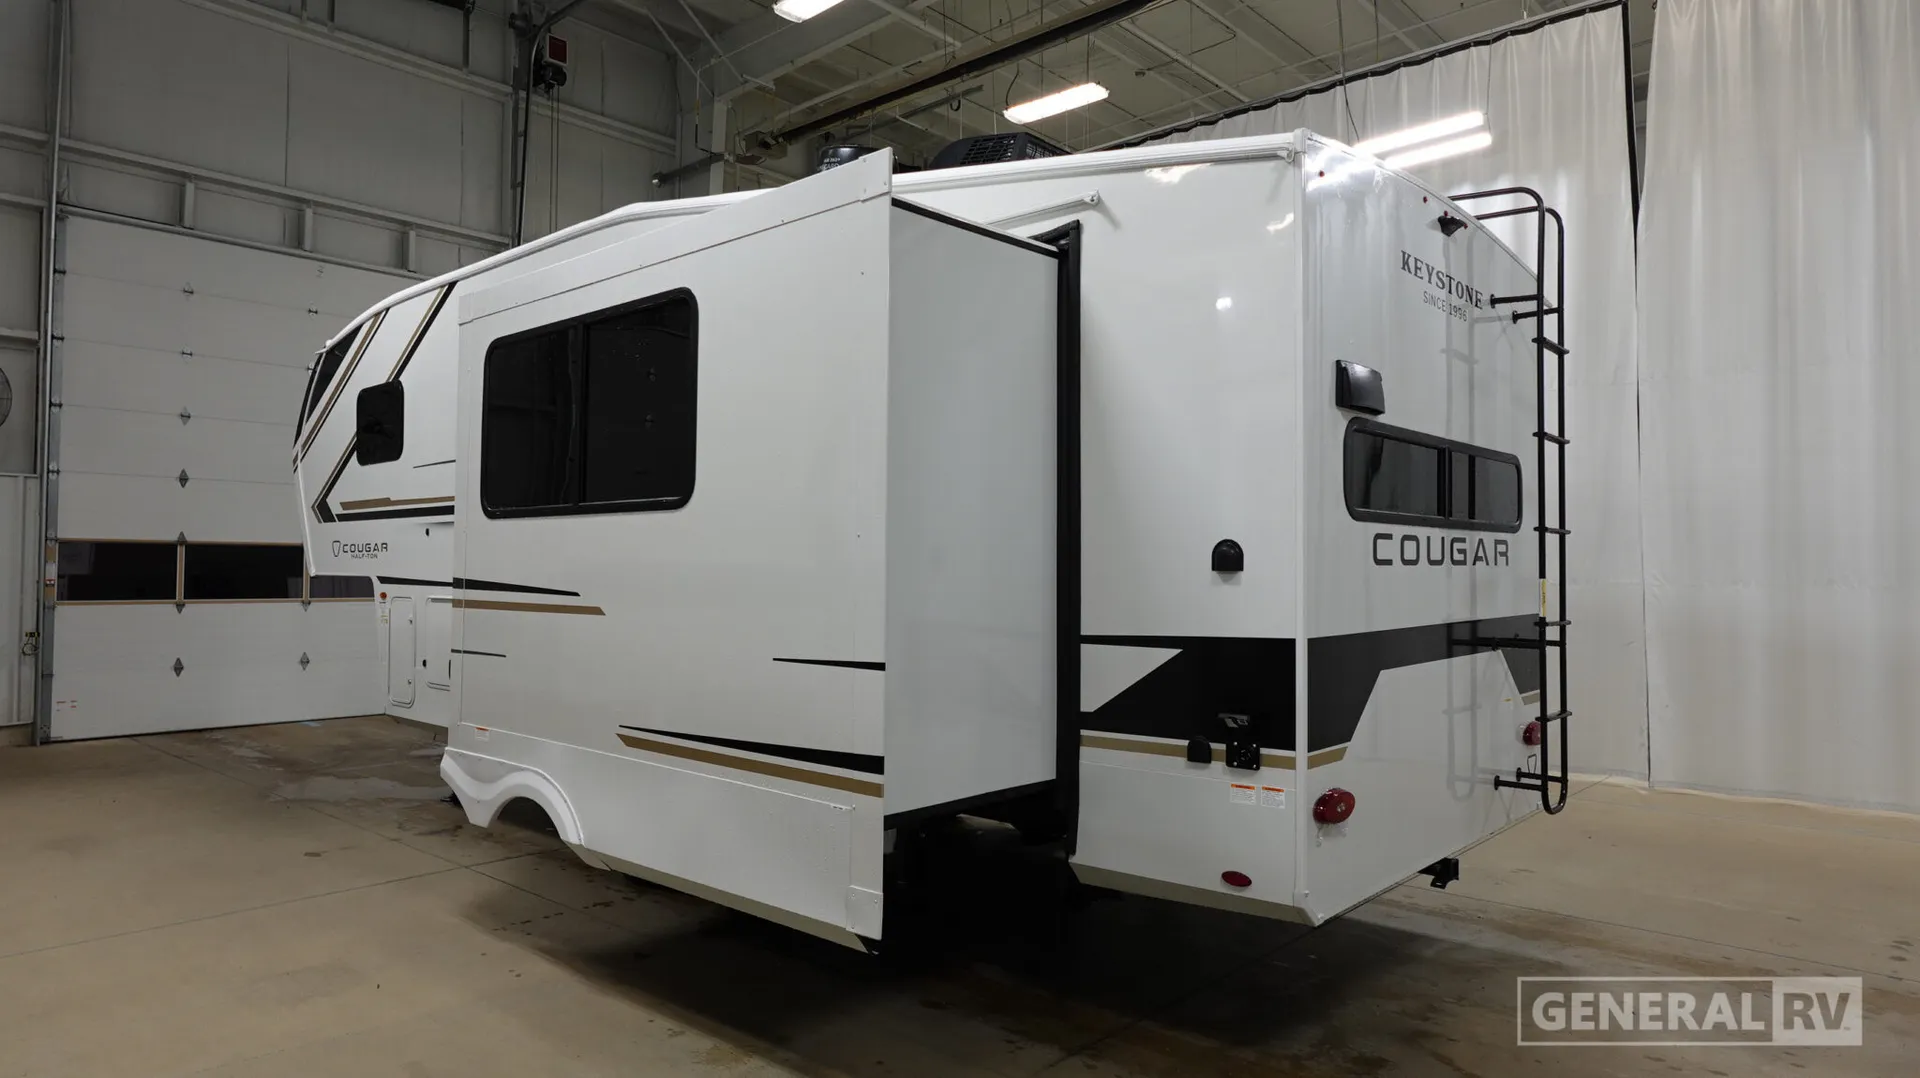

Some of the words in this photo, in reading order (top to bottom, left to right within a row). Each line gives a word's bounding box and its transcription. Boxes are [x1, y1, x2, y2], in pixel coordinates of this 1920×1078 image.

[1401, 249, 1483, 310] KEYSTONE
[1423, 290, 1447, 313] SINCE
[1449, 303, 1468, 322] 1996
[342, 542, 388, 553] COUGAR
[1372, 532, 1509, 566] COUGAR
